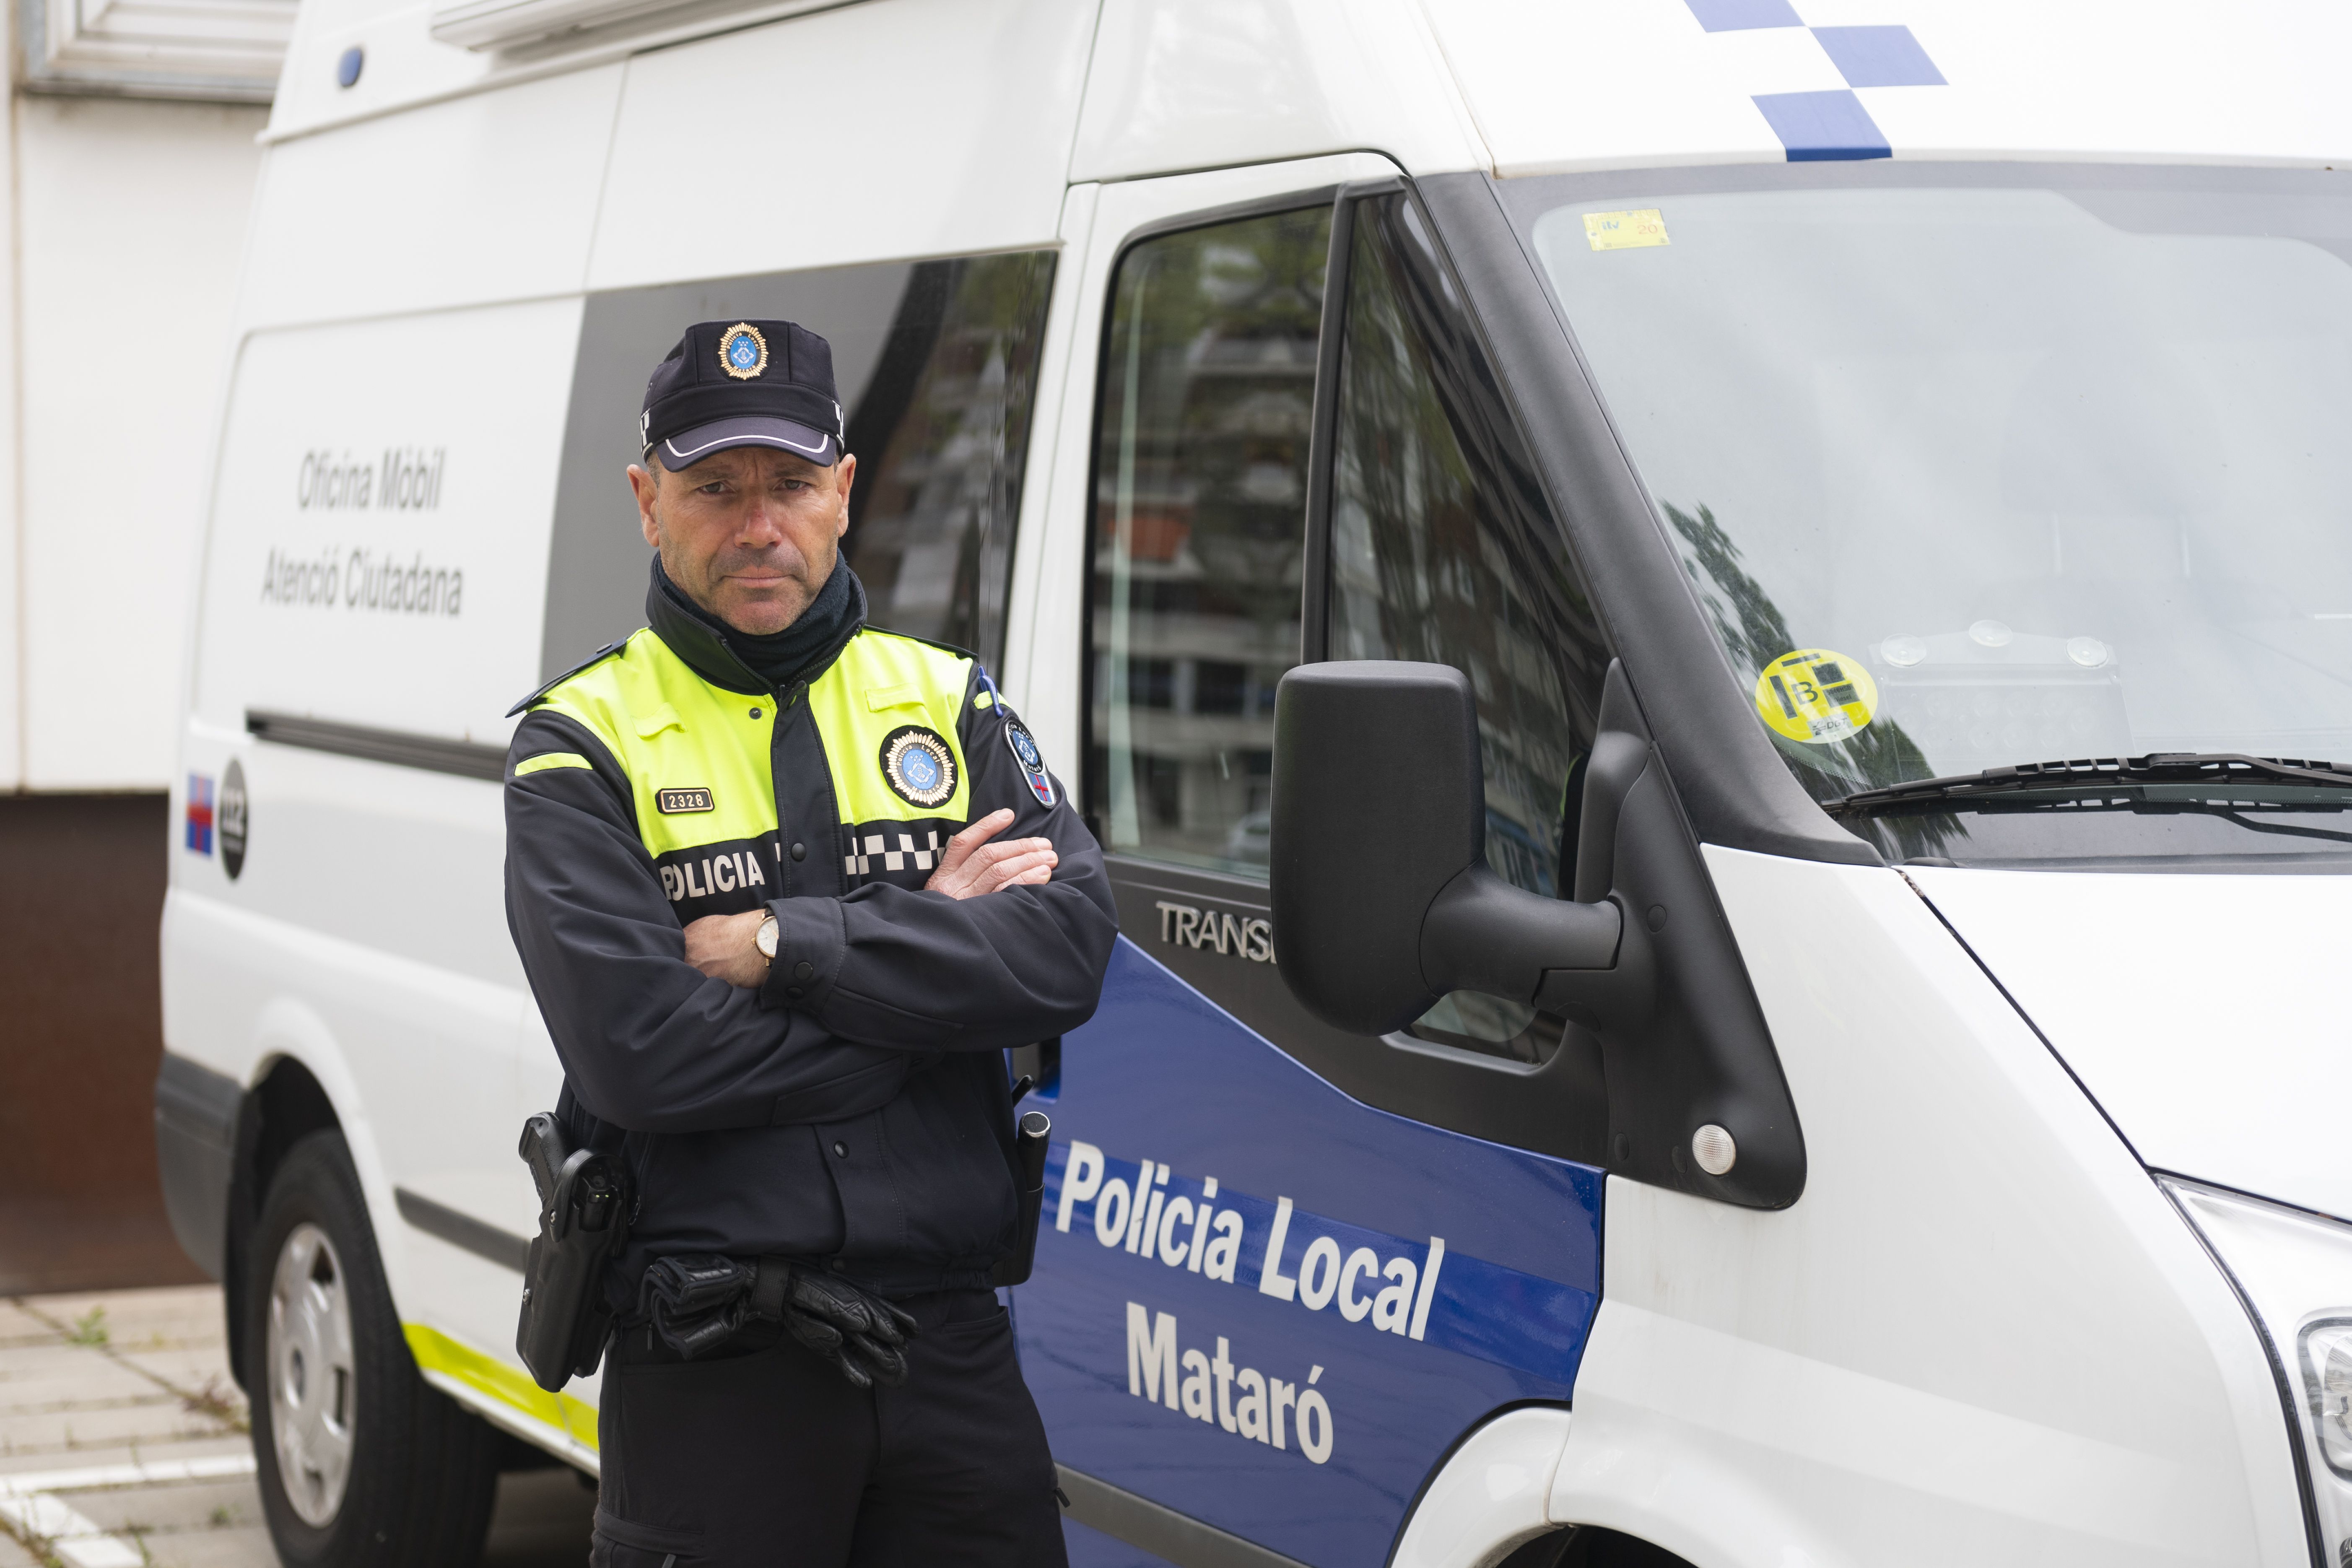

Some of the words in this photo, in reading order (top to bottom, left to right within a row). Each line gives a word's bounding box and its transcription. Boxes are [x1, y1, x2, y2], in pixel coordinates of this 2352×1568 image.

[1637, 224, 1658, 235] 20
[298, 447, 372, 510] Oficina
[261, 544, 339, 608] Atenció
[345, 545, 463, 618] Ciutadana
[1790, 681, 1818, 706] B
[1827, 717, 1848, 729] DGT
[896, 745, 913, 766] Policia
[921, 745, 940, 763] Local
[669, 794, 704, 808] 2328
[659, 851, 766, 901] POLICIA
[1055, 1140, 1244, 1284] Policia
[1259, 1196, 1445, 1342] Local
[1126, 1301, 1334, 1464] Mataró
